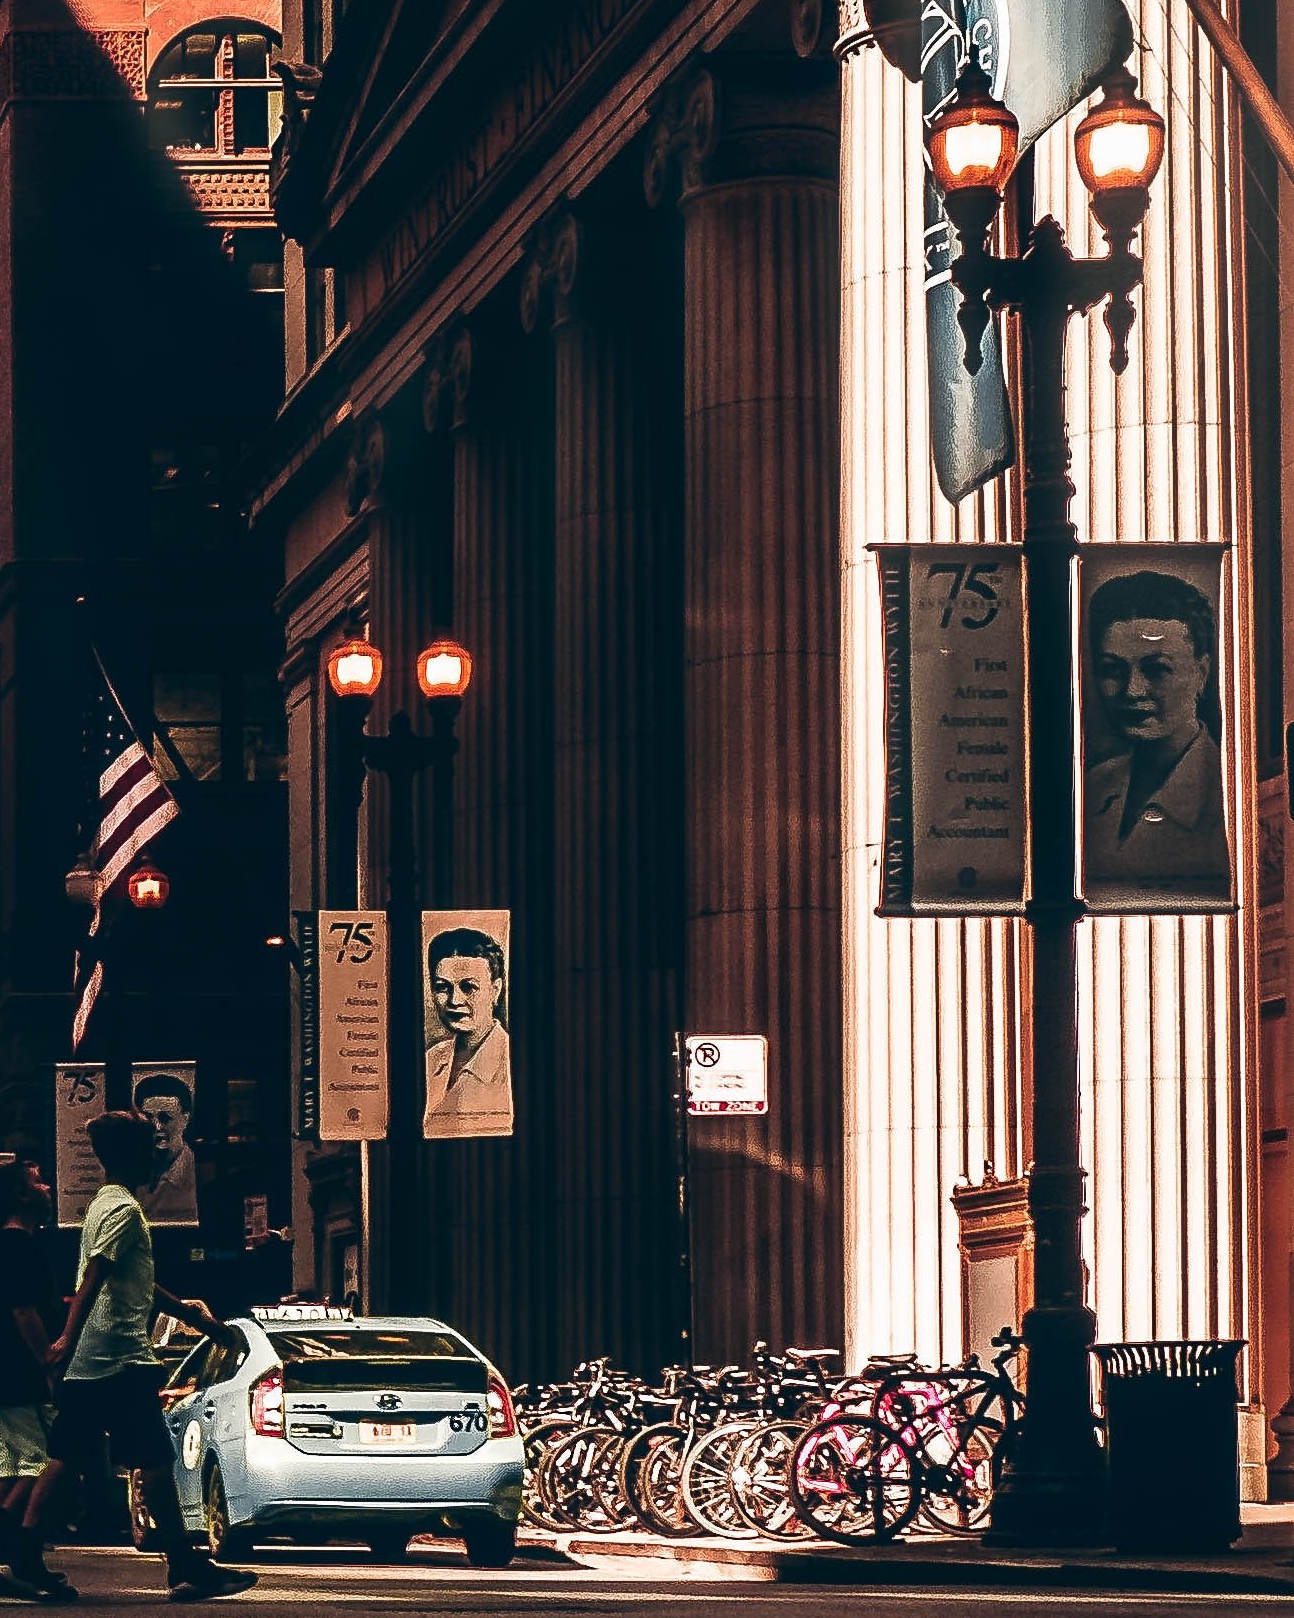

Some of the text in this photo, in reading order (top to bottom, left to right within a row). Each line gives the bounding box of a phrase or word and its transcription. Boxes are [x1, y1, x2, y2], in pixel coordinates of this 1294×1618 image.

[378, 126, 494, 289] WINTRUST
[928, 563, 999, 630] 75
[974, 657, 1008, 673] First
[953, 685, 1009, 700] African
[887, 647, 903, 800] WASHINGTON
[939, 713, 1009, 728] American
[956, 741, 1009, 756] Female
[944, 768, 1010, 784] Certified
[963, 795, 1010, 811] Public
[927, 824, 1010, 839] Accountant
[887, 839, 904, 900] MARY
[329, 922, 374, 963] 75
[63, 1071, 96, 1103] 75
[449, 1412, 488, 1433] 670
